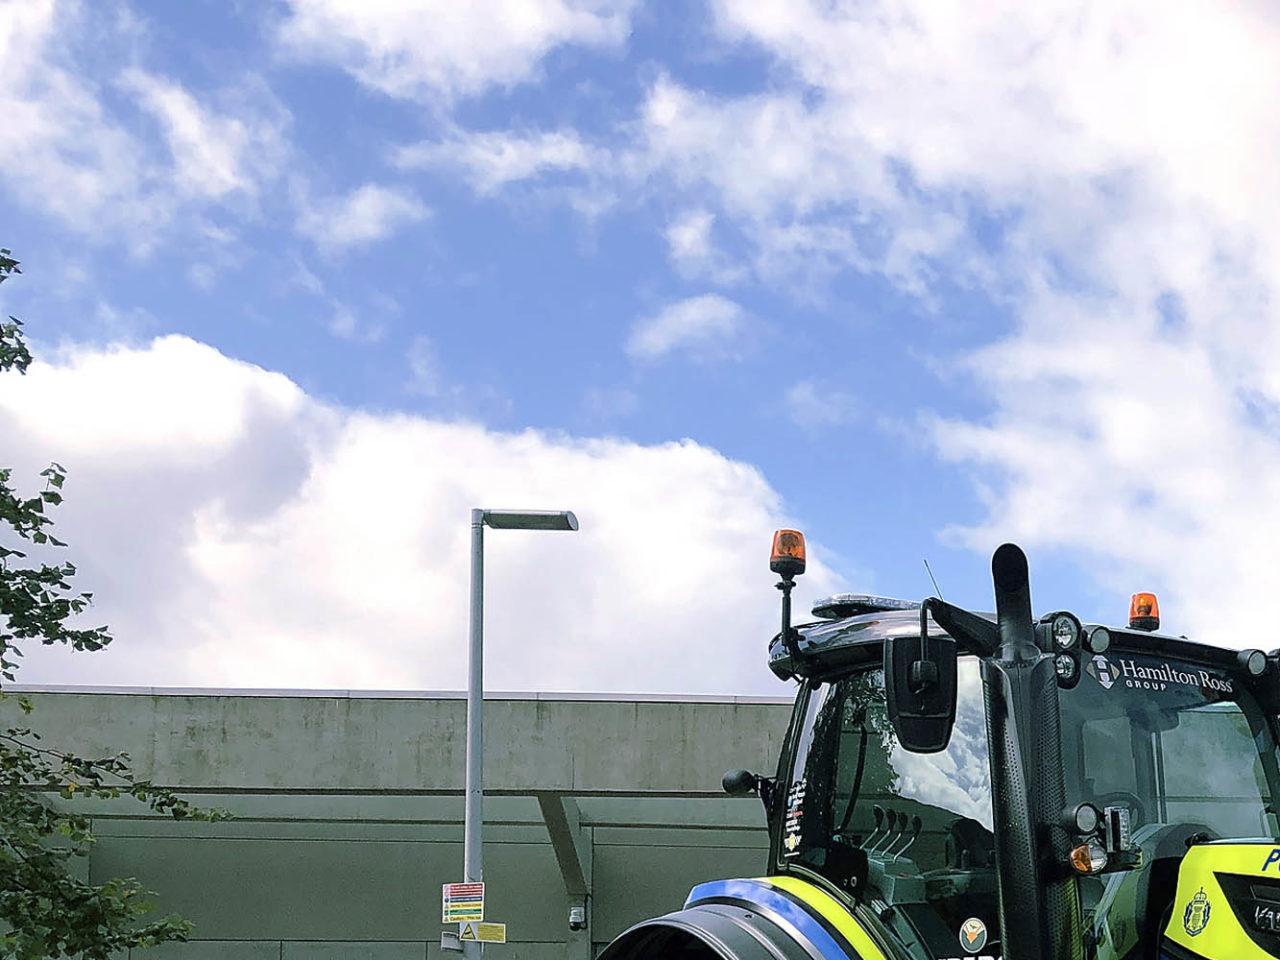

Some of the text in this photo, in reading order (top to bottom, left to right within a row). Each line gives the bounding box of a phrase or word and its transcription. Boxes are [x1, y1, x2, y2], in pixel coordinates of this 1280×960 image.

[1119, 660, 1233, 693] Hamilton Ross
[1126, 680, 1167, 691] GROUP
